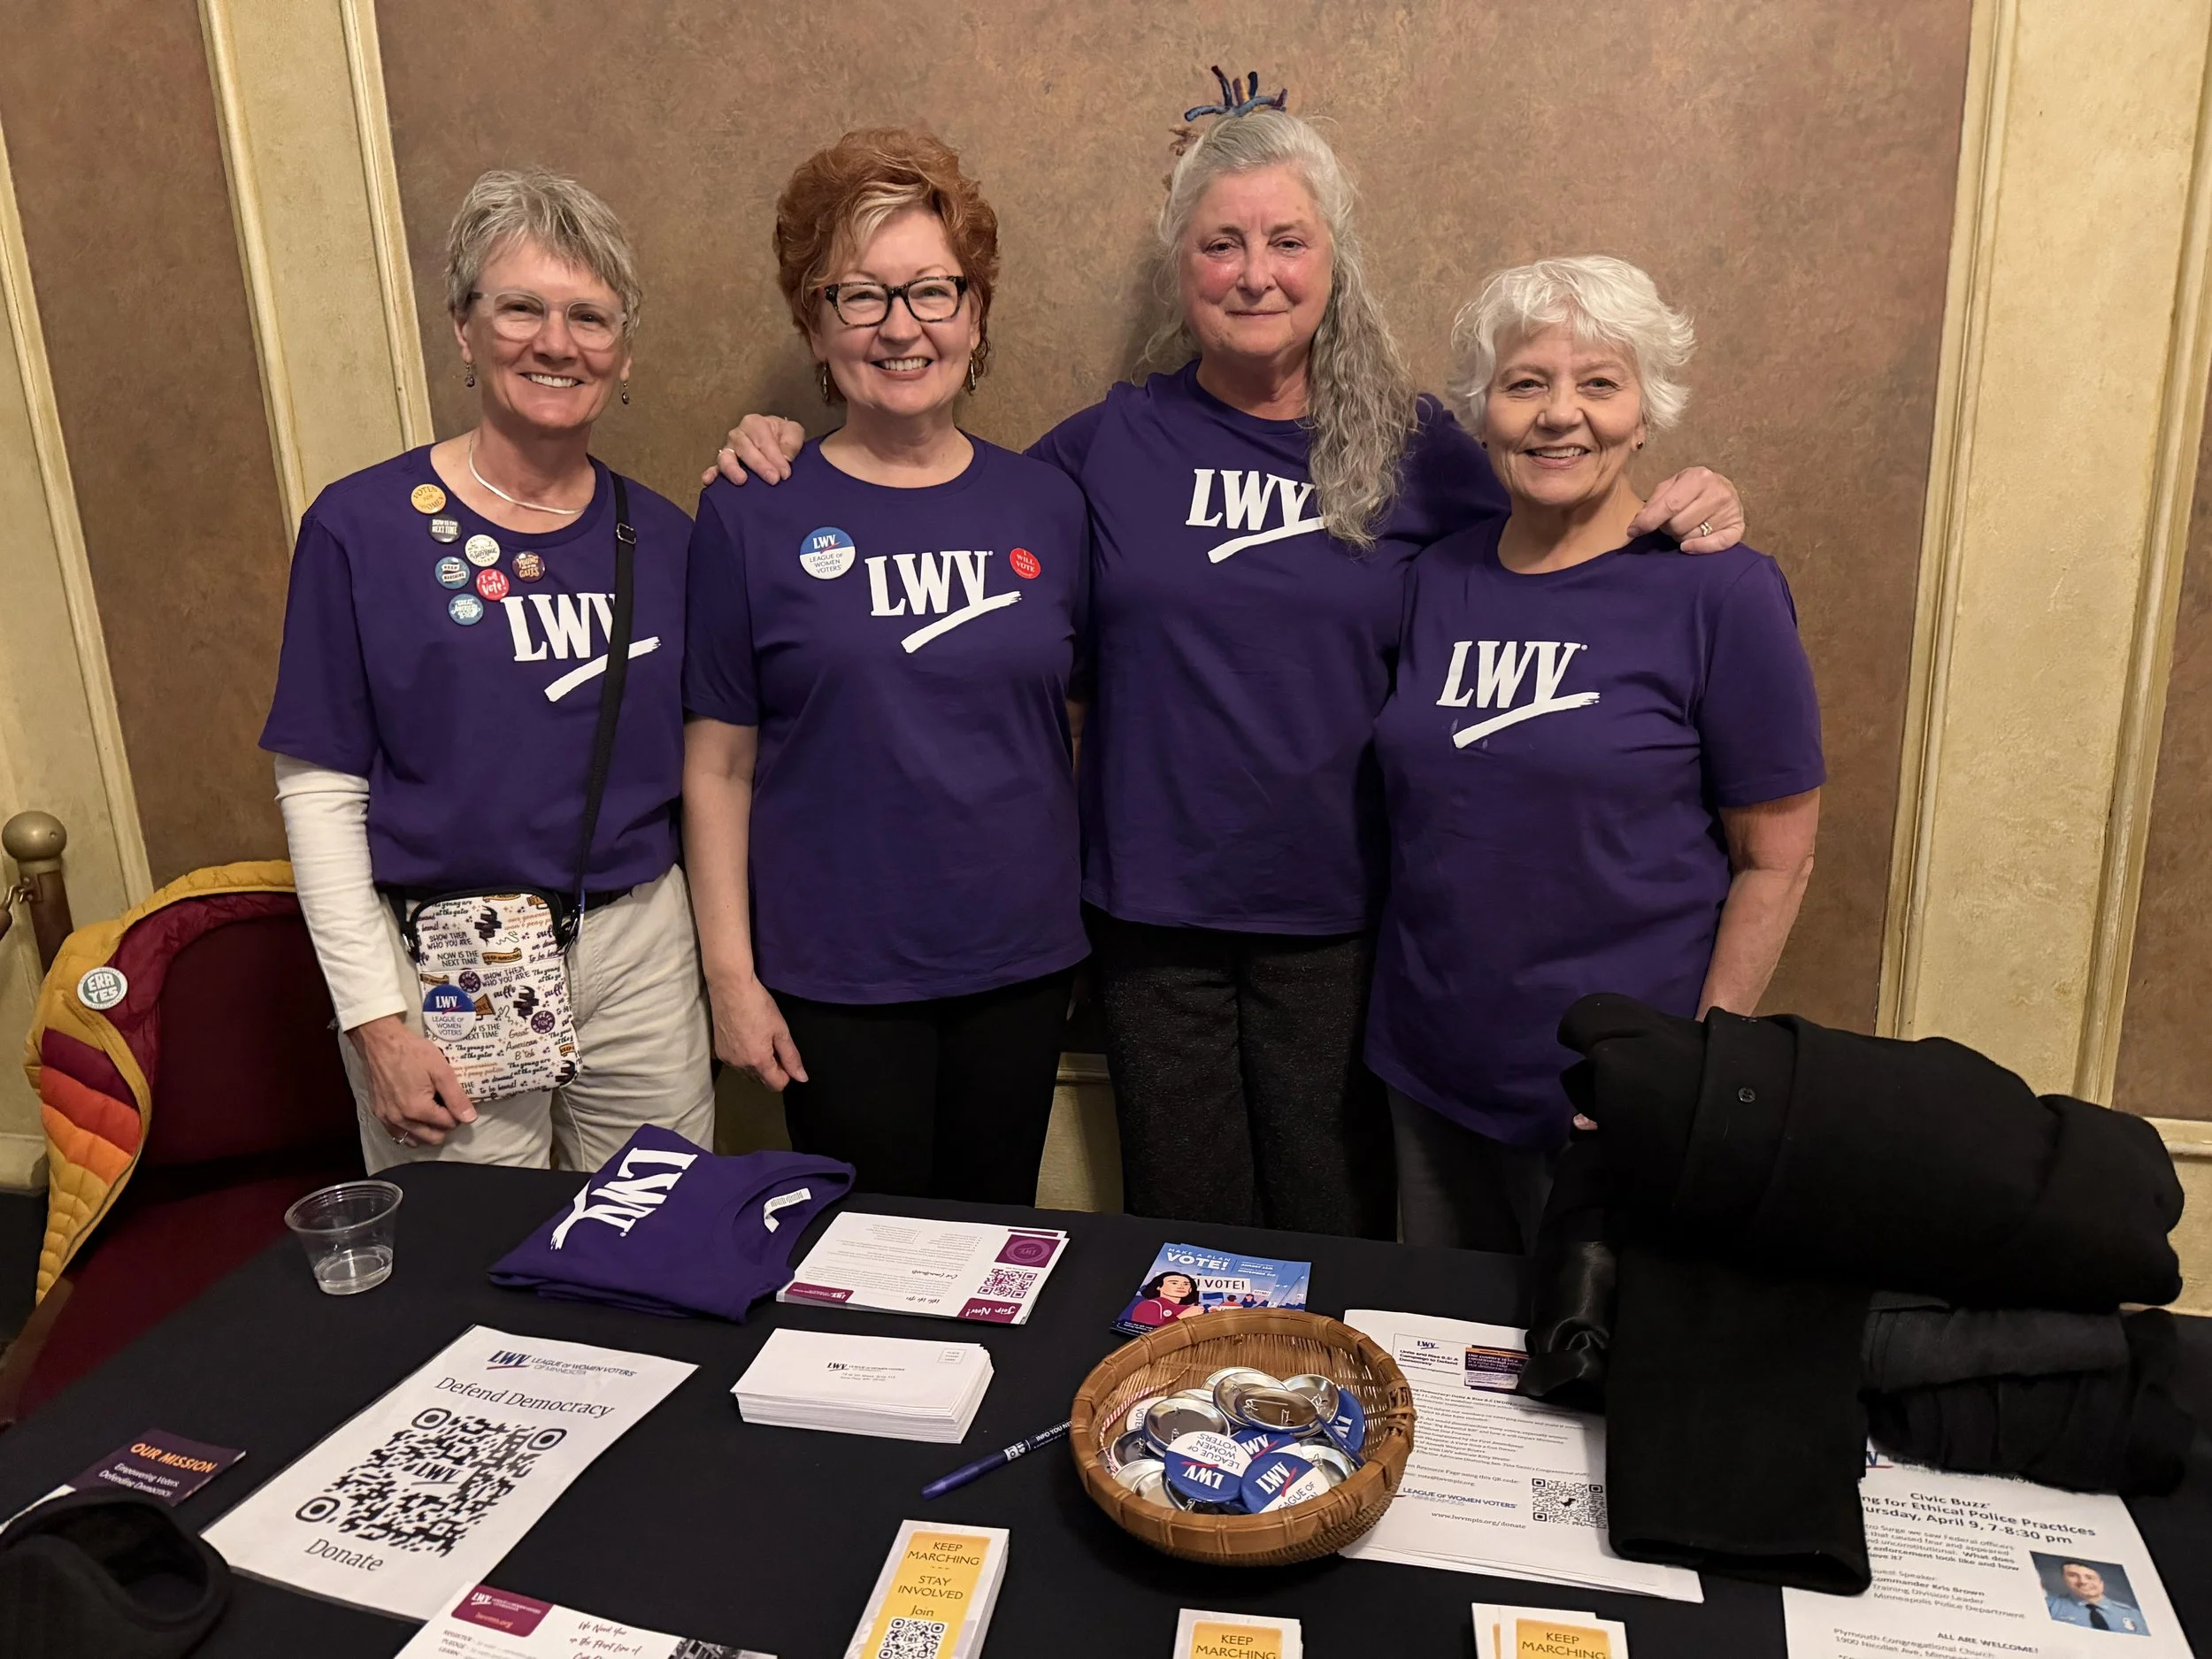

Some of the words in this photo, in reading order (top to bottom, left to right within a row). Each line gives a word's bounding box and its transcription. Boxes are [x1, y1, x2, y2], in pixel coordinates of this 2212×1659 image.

[1185, 468, 1320, 546] LWV
[812, 534, 837, 549] LWV
[518, 557, 539, 566] YOUNG
[810, 553, 833, 563] LEAGUE
[1016, 553, 1035, 565] WILL
[1016, 560, 1035, 572] VOTE
[518, 568, 540, 578] GATES
[816, 565, 841, 573] VOTERS
[864, 550, 1004, 633] LWV
[500, 593, 624, 680] LWV
[1435, 641, 1589, 727] LWV
[429, 933, 448, 942] SHOW
[87, 973, 115, 992] ERA
[483, 972, 502, 980] SHOW
[515, 971, 531, 980] ARE
[88, 986, 118, 1002] YES
[435, 996, 458, 1009] LWV
[509, 1027, 530, 1038] Great
[506, 1040, 538, 1051] American
[1167, 1252, 1229, 1271] VOTE!
[1202, 1278, 1245, 1290] VOTE!
[965, 1306, 992, 1317] Now!
[995, 1306, 1016, 1315] Join
[487, 1350, 532, 1368] LWV
[531, 1357, 562, 1367] LEAGUE
[573, 1363, 604, 1372] WOMEN
[603, 1367, 637, 1377] VOTERS
[434, 1377, 509, 1403] Defend
[503, 1393, 615, 1418] Democracy
[1049, 1425, 1063, 1434] YOU
[1195, 1440, 1236, 1459] WOMEN
[1197, 1433, 1237, 1452] VOTERS
[130, 1442, 162, 1460] OUR
[158, 1452, 218, 1473] MISSION
[1200, 1451, 1240, 1470] LEAGUE
[98, 1470, 135, 1487] Defending
[114, 1463, 157, 1483] Empowering
[412, 1463, 460, 1482] LWV
[1182, 1465, 1225, 1490] LWV
[1256, 1462, 1292, 1494] LWV
[1305, 1481, 1316, 1491] OF
[1402, 1486, 1435, 1497] LEAGUE
[1447, 1494, 1482, 1504] WOMEN
[1482, 1499, 1518, 1509] VOTERS
[1910, 1492, 1947, 1504] Civic
[1431, 1511, 1527, 1530] www.lwvmpls.org/donate
[1865, 1506, 1921, 1522] ursday,
[1925, 1514, 1964, 1527] April
[1969, 1520, 1985, 1531] 9,
[1987, 1523, 2040, 1540] 7-8:30
[2045, 1534, 2073, 1544] pm
[1885, 1497, 1905, 1508] for
[1912, 1502, 1964, 1516] Ethical
[1969, 1509, 2017, 1524] Police
[2021, 1517, 2096, 1537] Practices
[1870, 1531, 1889, 1540] that
[933, 1541, 963, 1552] KEEP
[304, 1538, 384, 1572] Donate
[907, 1551, 980, 1566] MARCHING
[1873, 1546, 1933, 1559] enforcement
[1935, 1554, 1957, 1563] look
[1998, 1563, 2019, 1571] how
[1962, 1550, 1989, 1561] What
[1991, 1555, 2016, 1564] does
[918, 1575, 952, 1586] STAY
[1872, 1576, 1930, 1588] Commander
[1932, 1584, 1951, 1593] Kris
[1952, 1586, 1985, 1597] Brown
[471, 1592, 493, 1603] LWV
[897, 1585, 964, 1601] INVOLVED
[1872, 1583, 1910, 1595] Training
[1911, 1588, 1949, 1600] Division
[1951, 1594, 1984, 1604] Leader
[910, 1604, 934, 1617] Join
[1874, 1593, 1932, 1607] Minneapolis
[1934, 1600, 1963, 1610] Police
[1965, 1604, 2025, 1619] Department
[1221, 1634, 1254, 1646] KEEP
[1546, 1632, 1580, 1645] KEEP
[1833, 1627, 1880, 1641] Plymouth
[1882, 1634, 1957, 1653] Congregational
[1959, 1646, 1996, 1658] Church
[1836, 1636, 1859, 1647] 1900
[1937, 1632, 1954, 1640] ALL
[1957, 1635, 1978, 1646] ARE
[1979, 1640, 2039, 1654] WELCOME!
[1195, 1645, 1276, 1659] MARCHING
[1521, 1641, 1607, 1659] MARCHING
